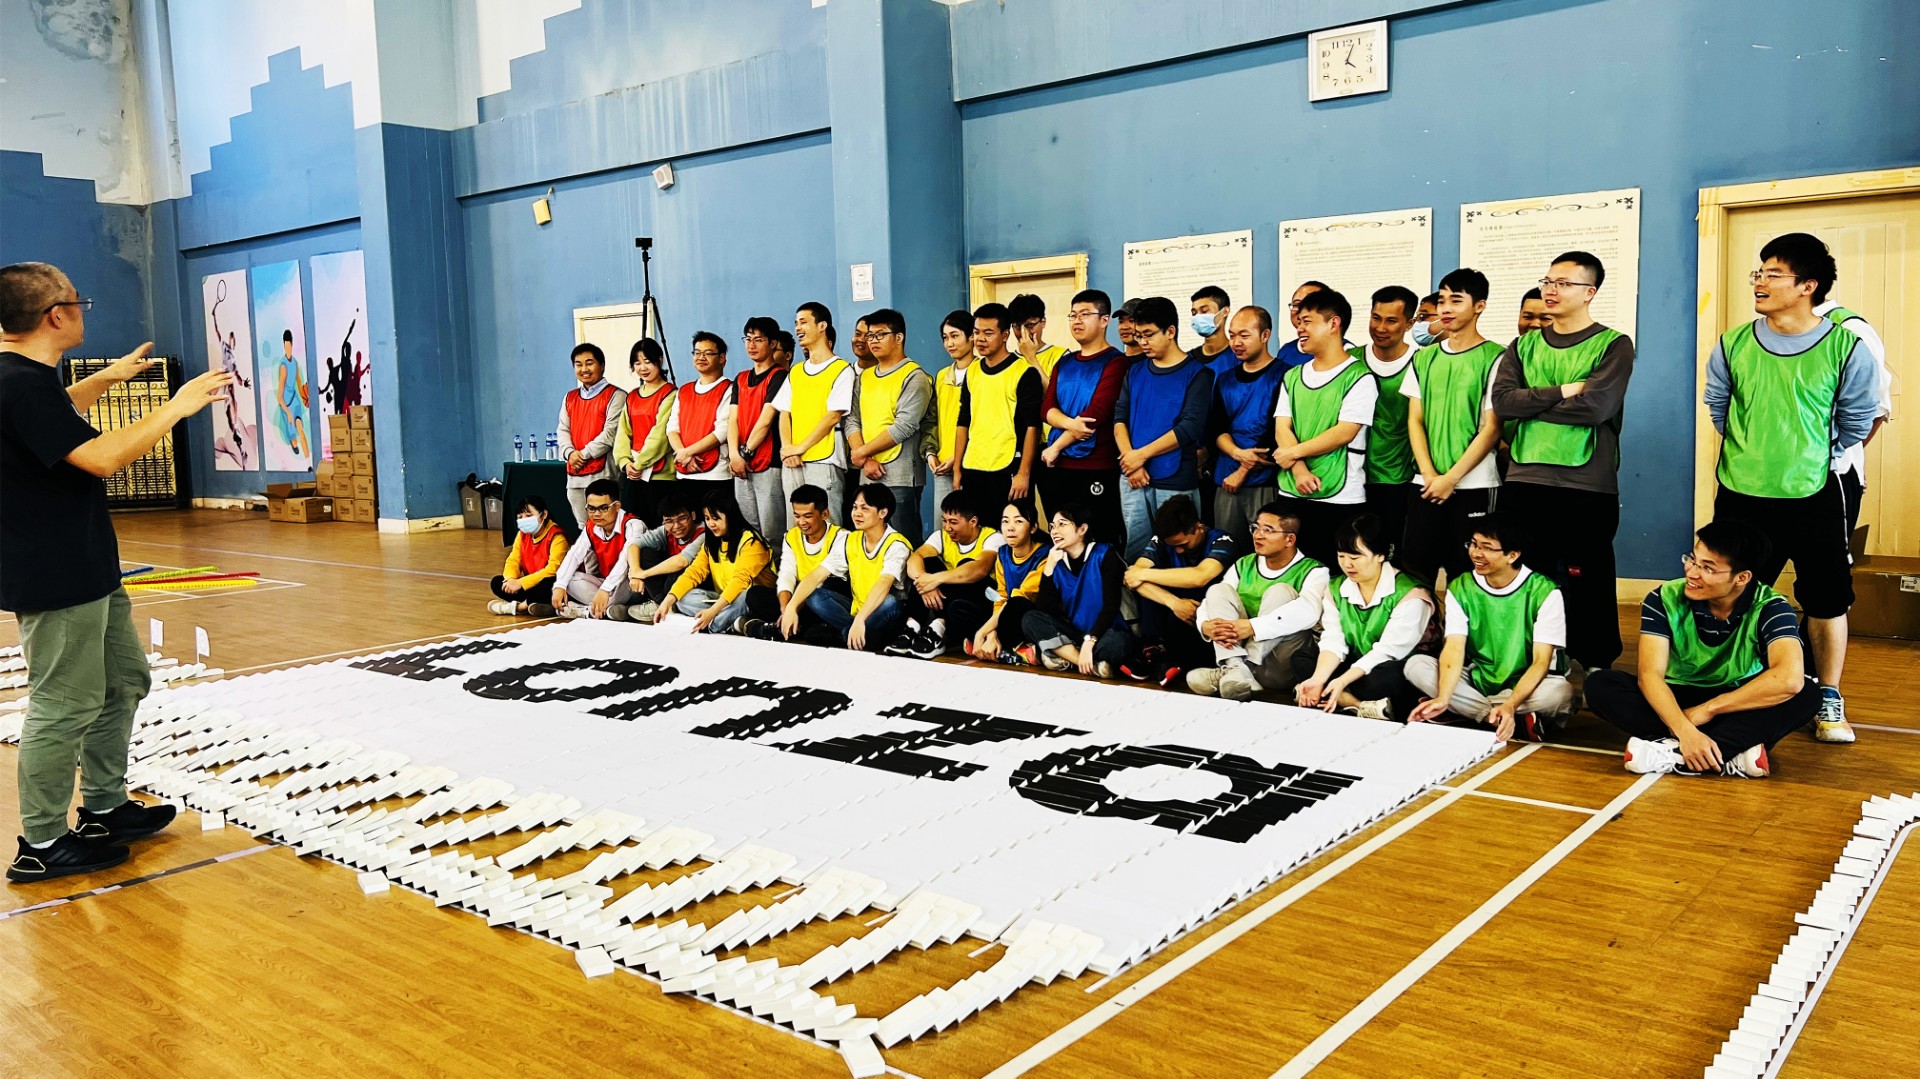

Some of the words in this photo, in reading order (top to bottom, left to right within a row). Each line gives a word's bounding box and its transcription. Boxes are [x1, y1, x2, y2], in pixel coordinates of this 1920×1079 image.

[1332, 41, 1339, 49] 11
[1342, 39, 1353, 47] 12
[1322, 50, 1331, 58] 10
[1332, 78, 1338, 86] 7
[1356, 75, 1363, 83] 5
[347, 639, 1364, 844] Lonza
